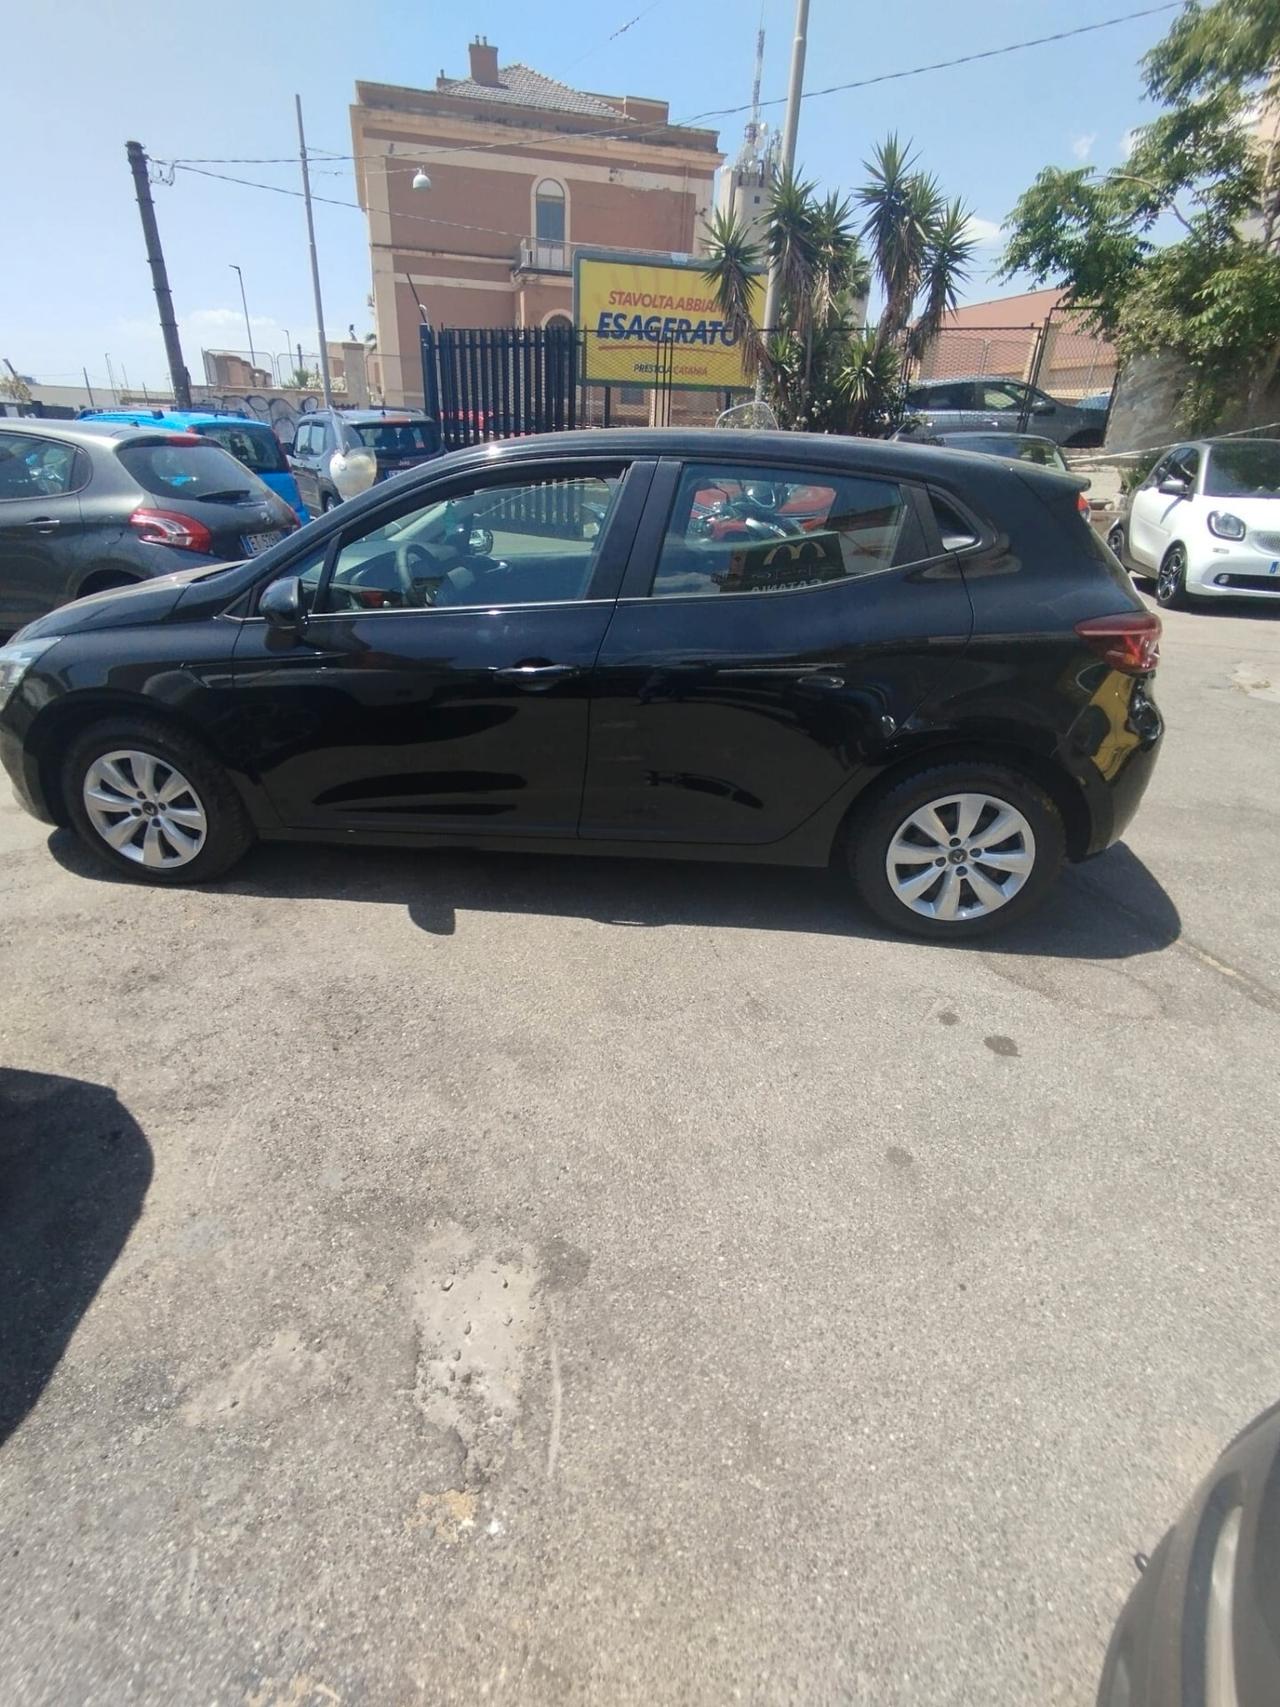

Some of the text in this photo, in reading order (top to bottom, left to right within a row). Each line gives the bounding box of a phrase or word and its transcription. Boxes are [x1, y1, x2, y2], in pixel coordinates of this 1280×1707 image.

[609, 290, 673, 309] STAVOLTA
[597, 312, 739, 346] ESAGERATO
[633, 364, 664, 374] PRESTO
[673, 365, 707, 375] CATANIA
